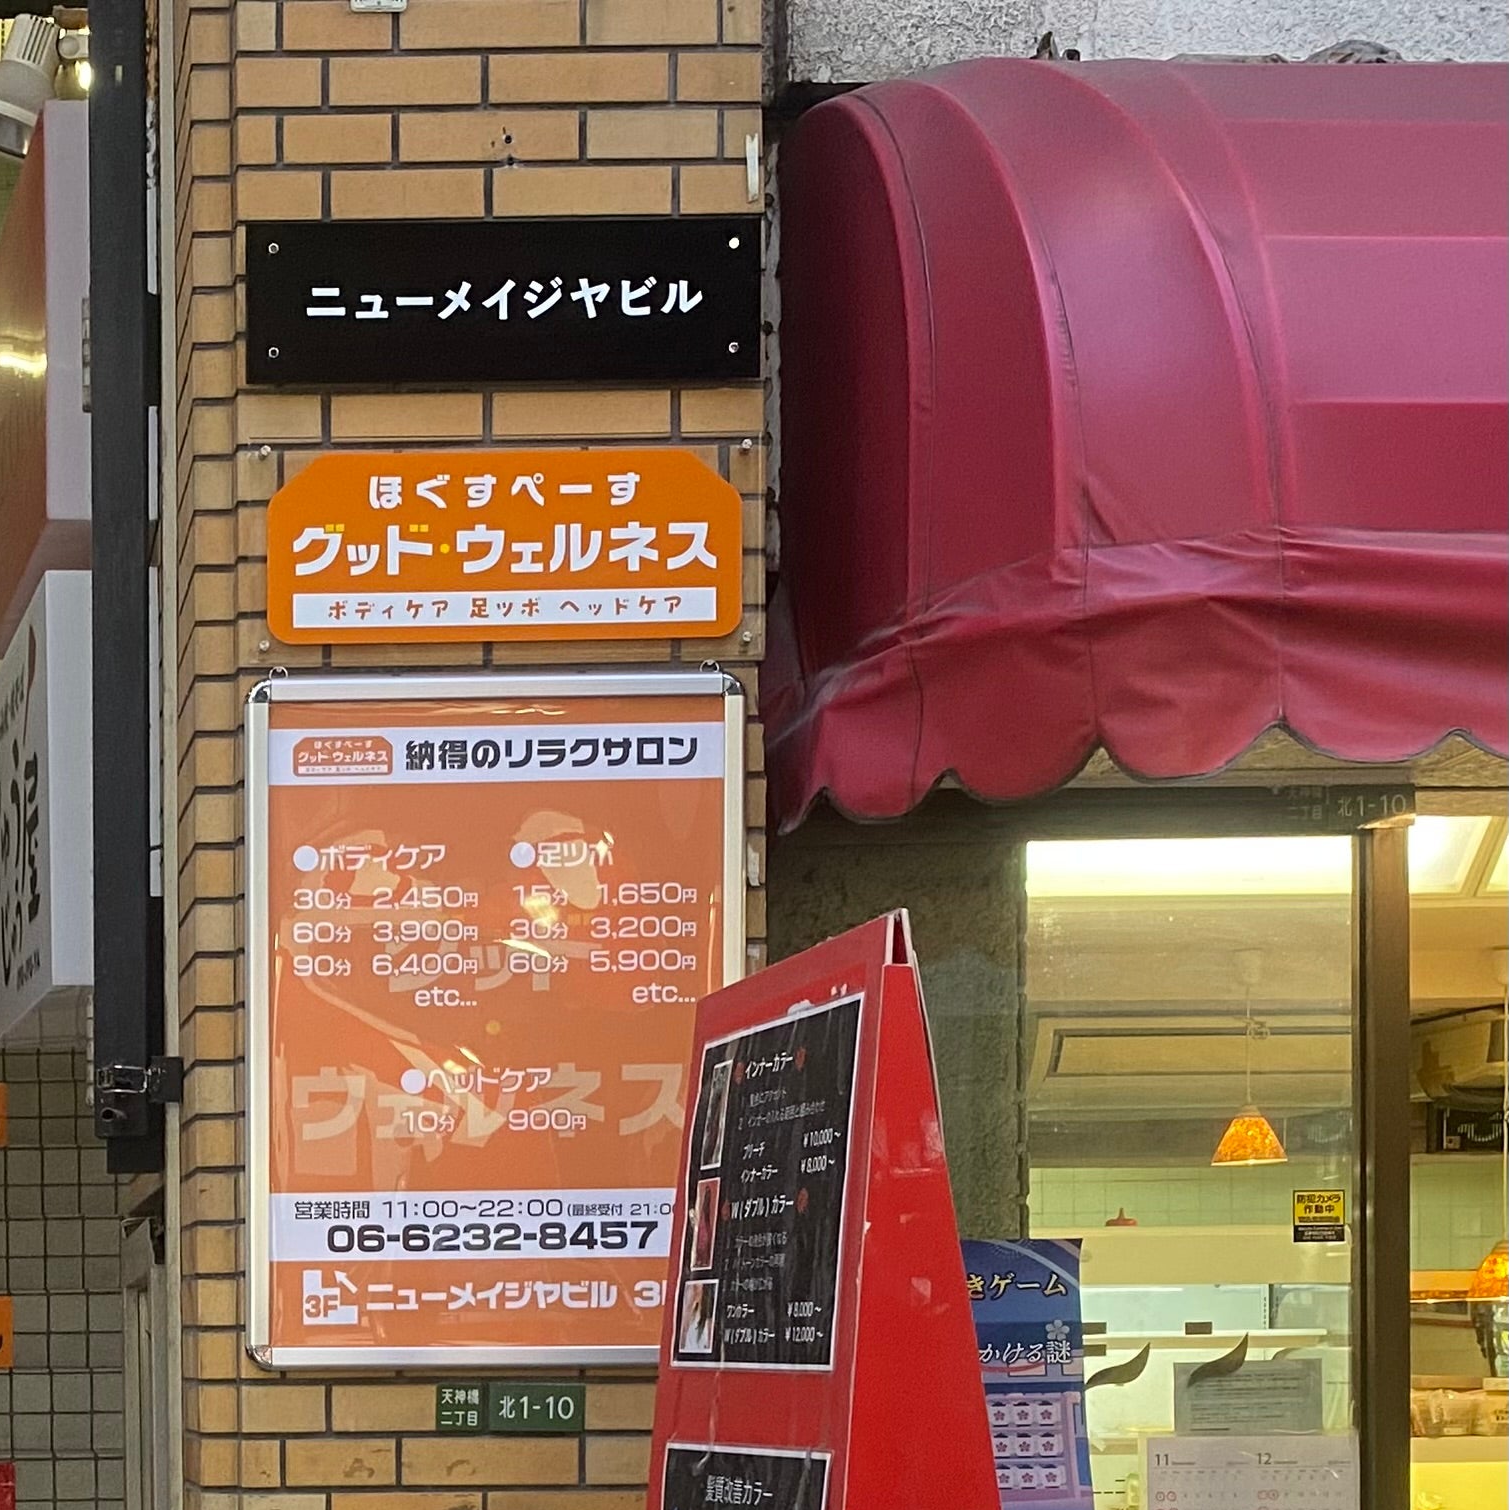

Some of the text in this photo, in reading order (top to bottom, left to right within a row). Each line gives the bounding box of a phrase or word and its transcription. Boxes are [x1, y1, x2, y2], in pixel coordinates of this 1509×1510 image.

[305, 277, 703, 320] ニューメイジヤビル
[369, 472, 641, 509] ほぐすぺーす
[293, 520, 718, 577] グッド・ウェルネス
[328, 595, 684, 622] ボディケア 足ツボ ヘッドケア
[405, 736, 698, 770] 納得のリラクサロン
[1338, 794, 1406, 817] 北1-10
[320, 845, 446, 871] ボディケア
[293, 885, 479, 911] 30分 2,450円
[596, 882, 697, 906] 1,650円
[293, 920, 478, 944] 60分 3,900円
[510, 916, 697, 941] 30分 3,200円
[293, 952, 478, 977] 90分 6,400円
[510, 949, 696, 974] 60分 5,900円
[415, 986, 477, 1007] etc...
[632, 983, 696, 1004] etc...
[746, 1052, 793, 1079] インナーカラー
[427, 1068, 552, 1094] ヘッドケア
[401, 1109, 586, 1132] 10分 900円
[740, 1164, 778, 1184] インナーカラー
[294, 1200, 370, 1220] 営業時間
[630, 1203, 676, 1216] 21:0
[327, 1221, 658, 1252] 06-6232-8457
[304, 1293, 338, 1318] 3F
[367, 1280, 617, 1310] ニューメイジヤビル
[979, 1340, 1072, 1364] かける謎
[441, 1388, 479, 1404] 天神橋
[499, 1396, 574, 1420] 北1-10
[441, 1411, 479, 1426] 二丁目
[1155, 1454, 1169, 1465] 11
[1257, 1453, 1272, 1465] 12
[705, 1474, 773, 1506] 髪質改善カラー
